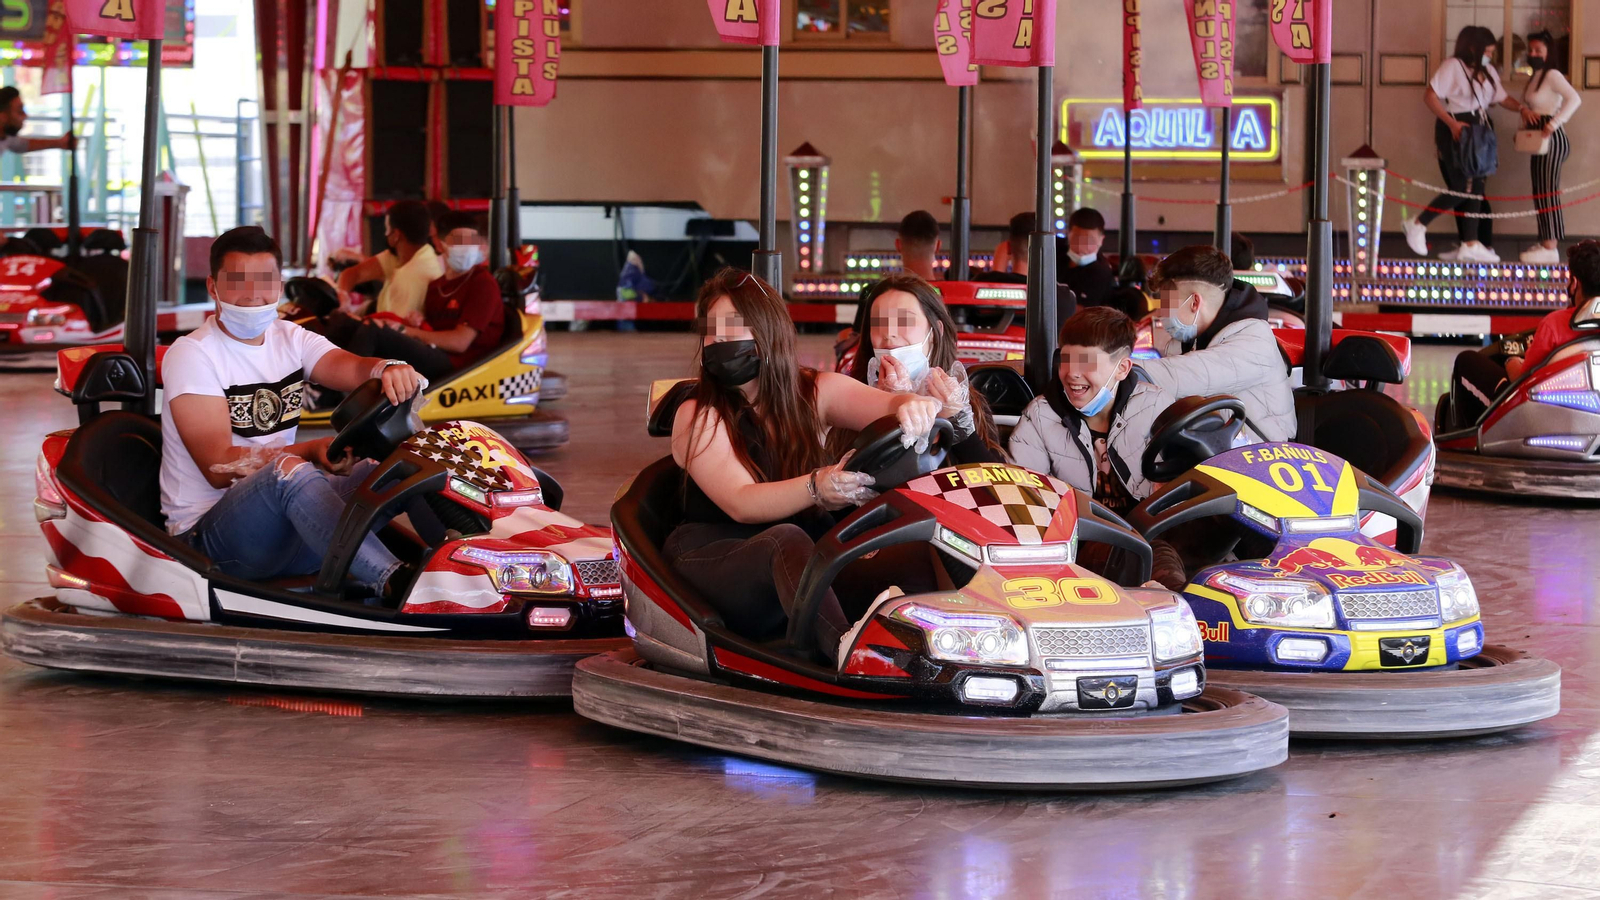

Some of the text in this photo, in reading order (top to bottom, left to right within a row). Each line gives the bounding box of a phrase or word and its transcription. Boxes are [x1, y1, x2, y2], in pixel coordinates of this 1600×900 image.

[511, 0, 535, 96] PISTA
[438, 383, 496, 408] TAXI
[1241, 443, 1329, 464] F.BAÑULS
[945, 464, 1045, 488] F.BAÑULS
[1268, 461, 1335, 493] 01
[1002, 577, 1120, 610] 30
